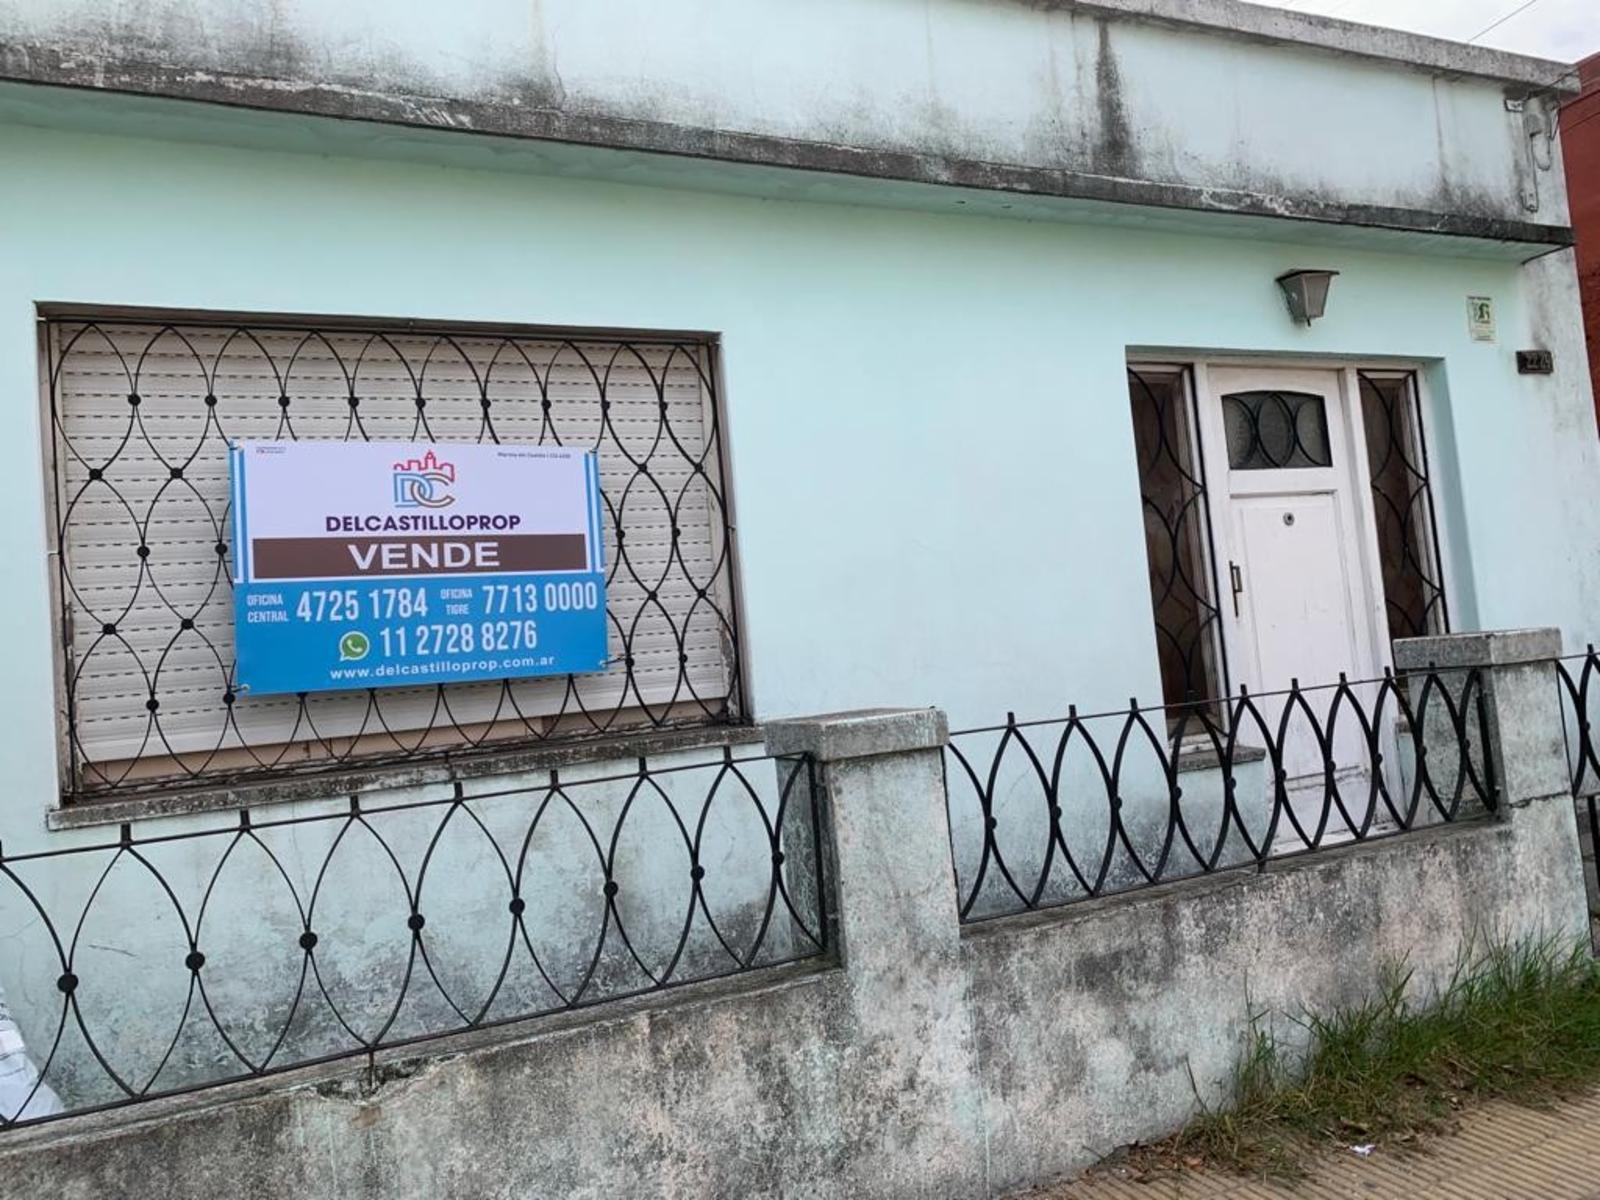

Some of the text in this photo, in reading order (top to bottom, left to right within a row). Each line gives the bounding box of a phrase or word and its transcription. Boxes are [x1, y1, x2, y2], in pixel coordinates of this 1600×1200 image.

[326, 515, 521, 532] DELCASTILLOPROP
[348, 542, 500, 570] VENDE
[247, 595, 283, 606] OFICINA
[440, 589, 472, 600] OFICINA
[483, 582, 598, 614] 7713 0000
[296, 588, 428, 622] 4725 1784
[446, 604, 469, 615] TIGRE
[248, 611, 288, 622] CENTRAL
[380, 621, 537, 656] 11 2728 8276
[330, 656, 555, 680] www.delcastilloprop.com.ar
